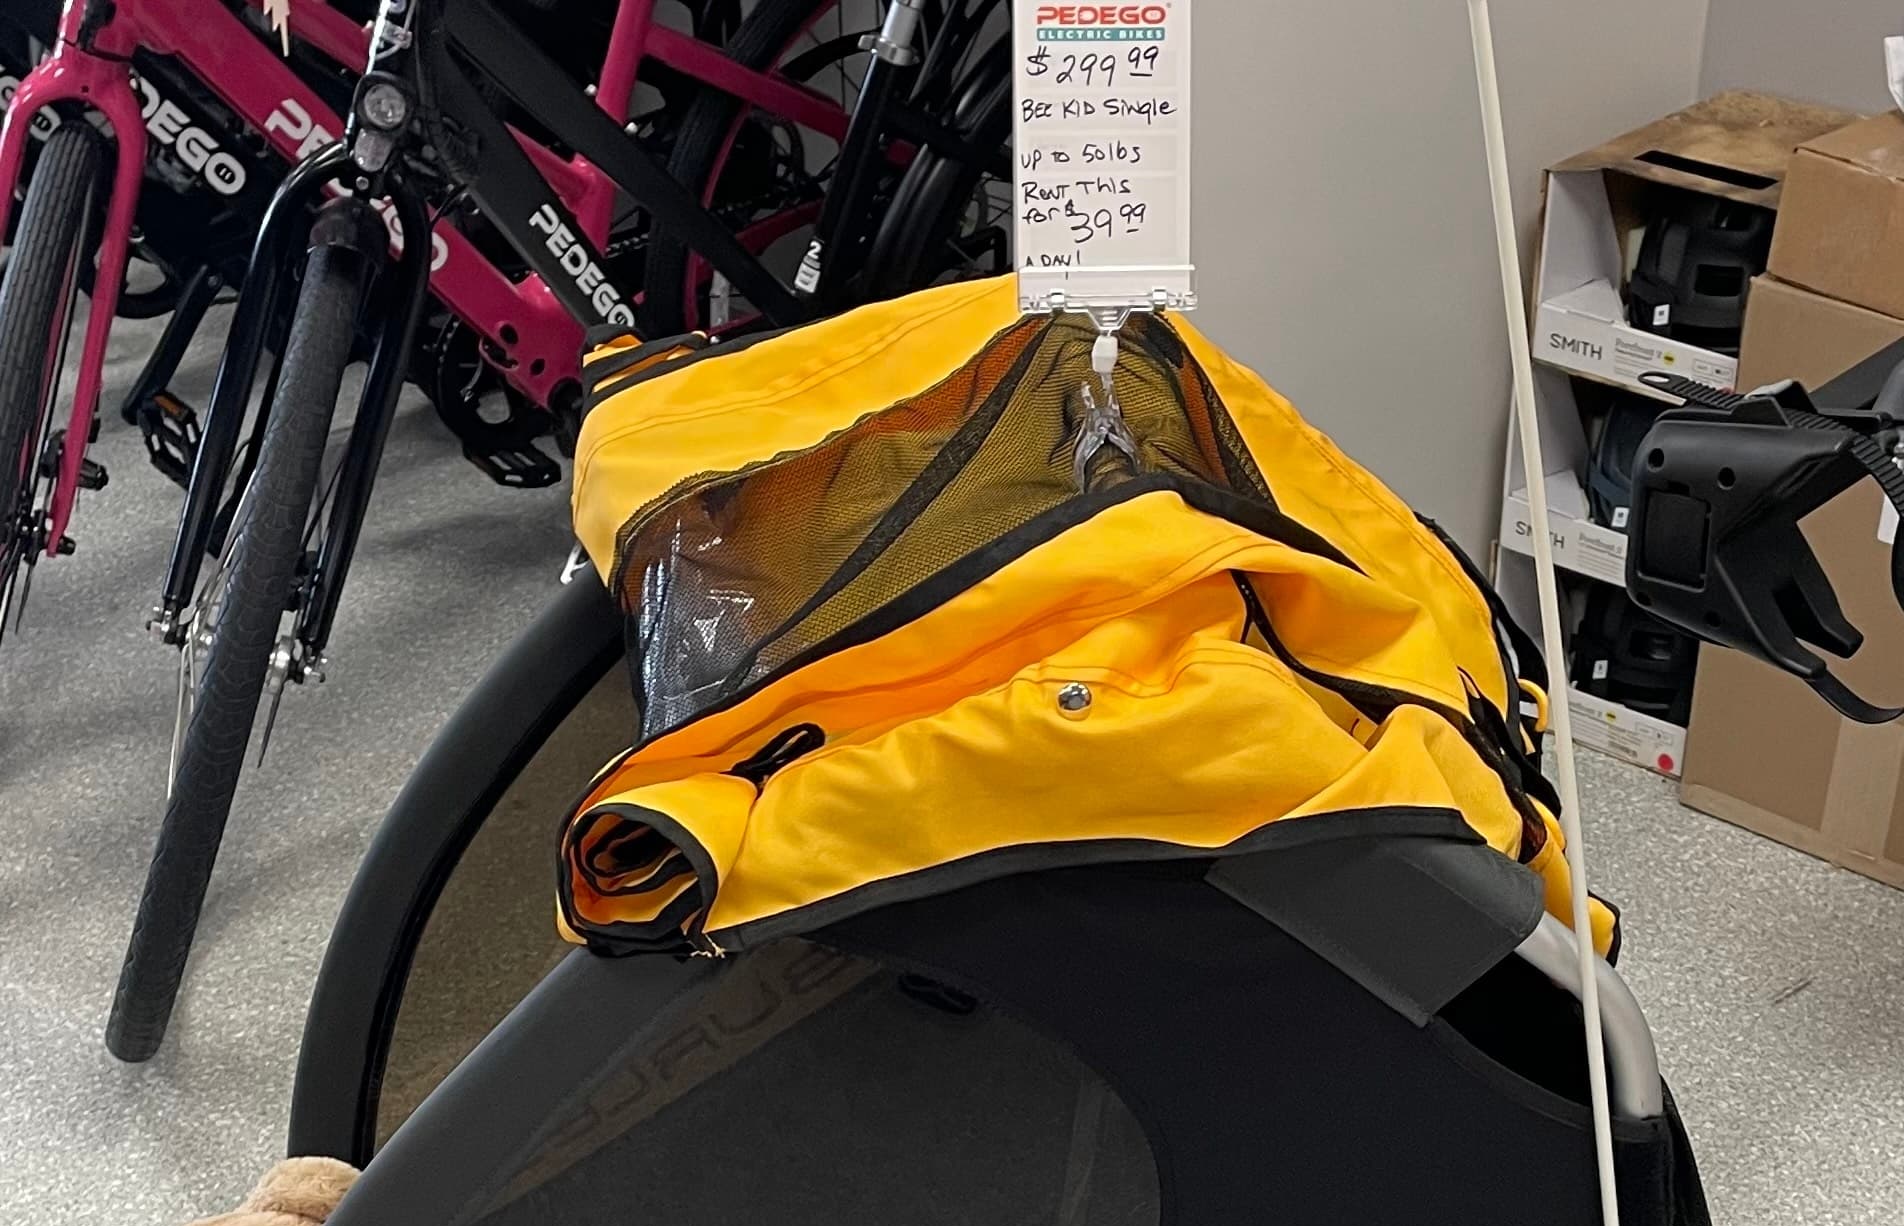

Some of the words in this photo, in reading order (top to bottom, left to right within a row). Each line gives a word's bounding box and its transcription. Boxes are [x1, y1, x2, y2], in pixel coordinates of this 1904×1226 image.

[1036, 6, 1166, 25] PEDEGO
[1039, 29, 1112, 39] ELECTRIC
[1119, 29, 1163, 39] BIKES
[1062, 98, 1096, 119] KID
[1022, 207, 1060, 224] for
[528, 203, 635, 328] PEDEGO
[1549, 333, 1603, 361] SMITH
